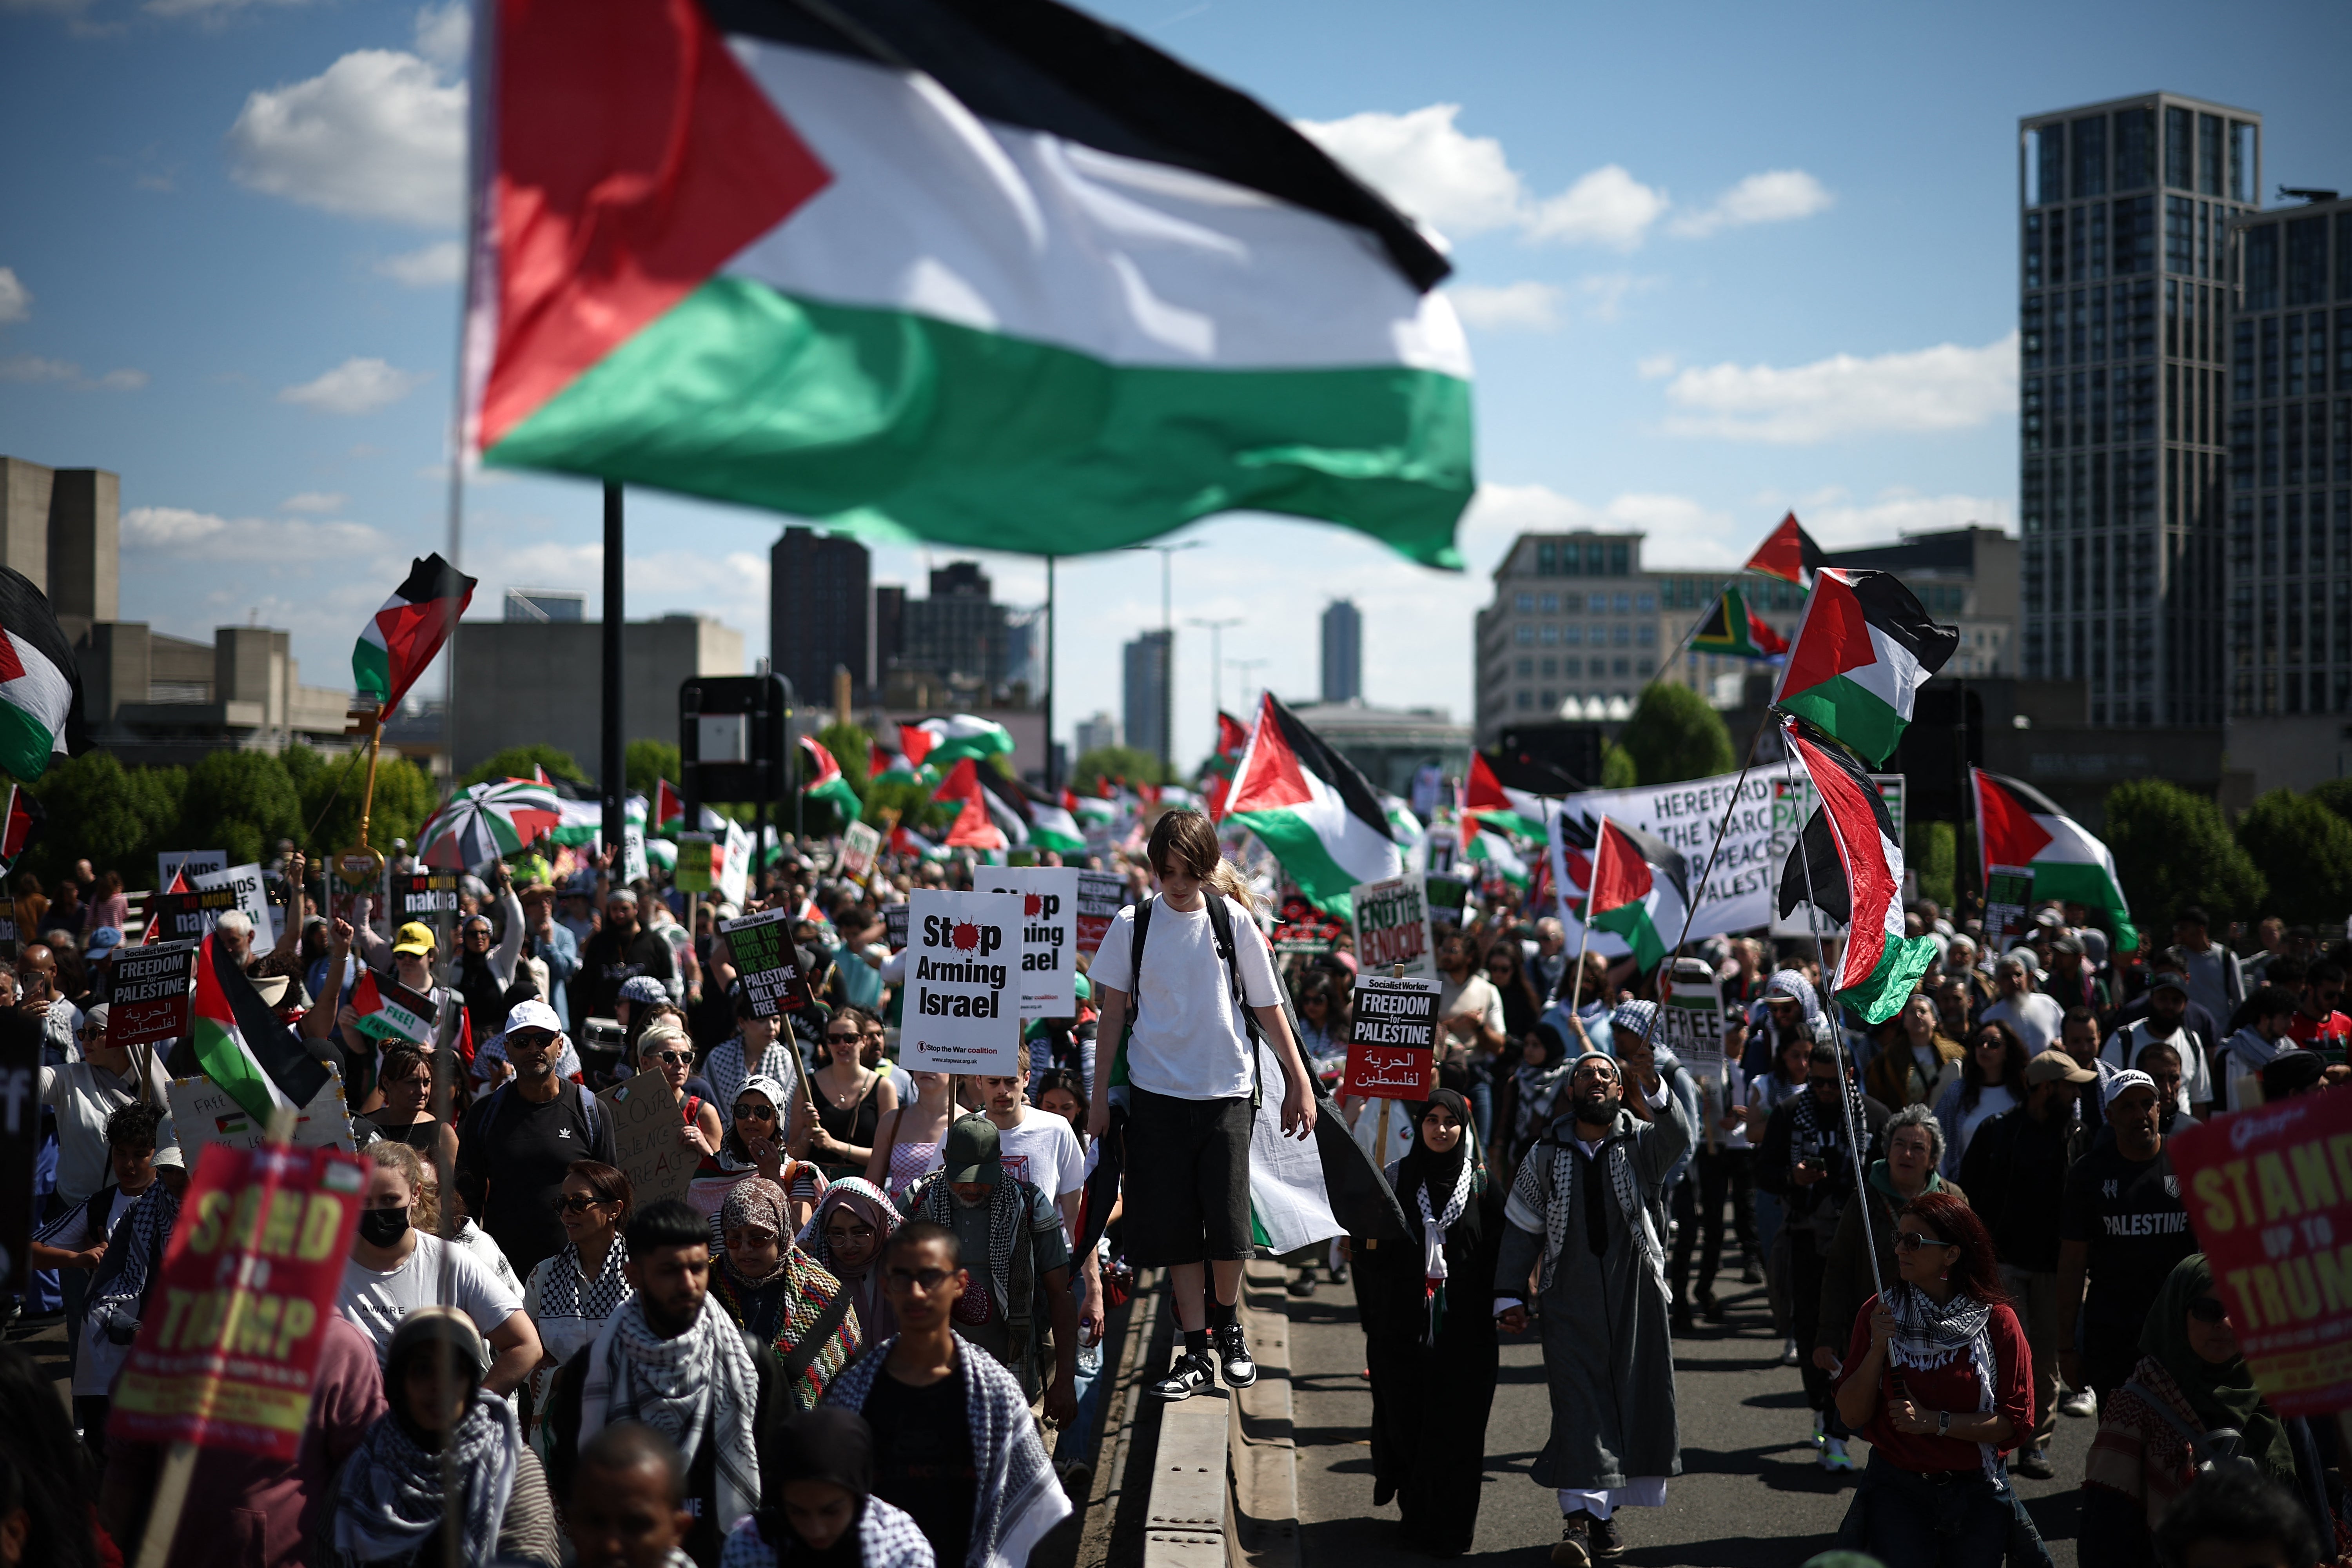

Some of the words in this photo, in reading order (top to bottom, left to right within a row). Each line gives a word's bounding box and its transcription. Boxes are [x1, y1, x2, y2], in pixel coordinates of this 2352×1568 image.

[413, 877, 426, 891] NO
[183, 897, 198, 909] NO
[201, 891, 234, 908] MORE
[731, 928, 759, 945] FROM
[759, 923, 780, 939] THE
[735, 943, 763, 959] RIVER
[765, 939, 779, 953] TO
[119, 954, 184, 978] FREEDOM
[739, 959, 760, 973] THE
[762, 954, 781, 969] SEA
[916, 956, 1006, 989] Arming
[744, 965, 797, 988] PALESTINE
[114, 977, 185, 1003] PALESTINE
[748, 987, 773, 1002] WILL
[773, 982, 789, 997] BE
[125, 1003, 171, 1022] الحرية
[753, 1000, 779, 1017] FREE
[919, 987, 999, 1018] Israel
[1361, 993, 1430, 1015] FREEDOM
[118, 1016, 176, 1039] لفلسطين
[1390, 1014, 1401, 1023] for
[1667, 1009, 1720, 1039] FREE
[1355, 1022, 1430, 1044] PALESTINE
[927, 1044, 940, 1053] Stop
[1364, 1050, 1414, 1070] الحرية
[1356, 1069, 1419, 1086] لفلسطين
[194, 1094, 226, 1114] FREE
[630, 1089, 672, 1123] OUR
[661, 1176, 676, 1188] OF
[2103, 1212, 2187, 1236] PALESTINE
[2301, 1217, 2332, 1248] TO
[362, 1304, 405, 1314] AWARE
